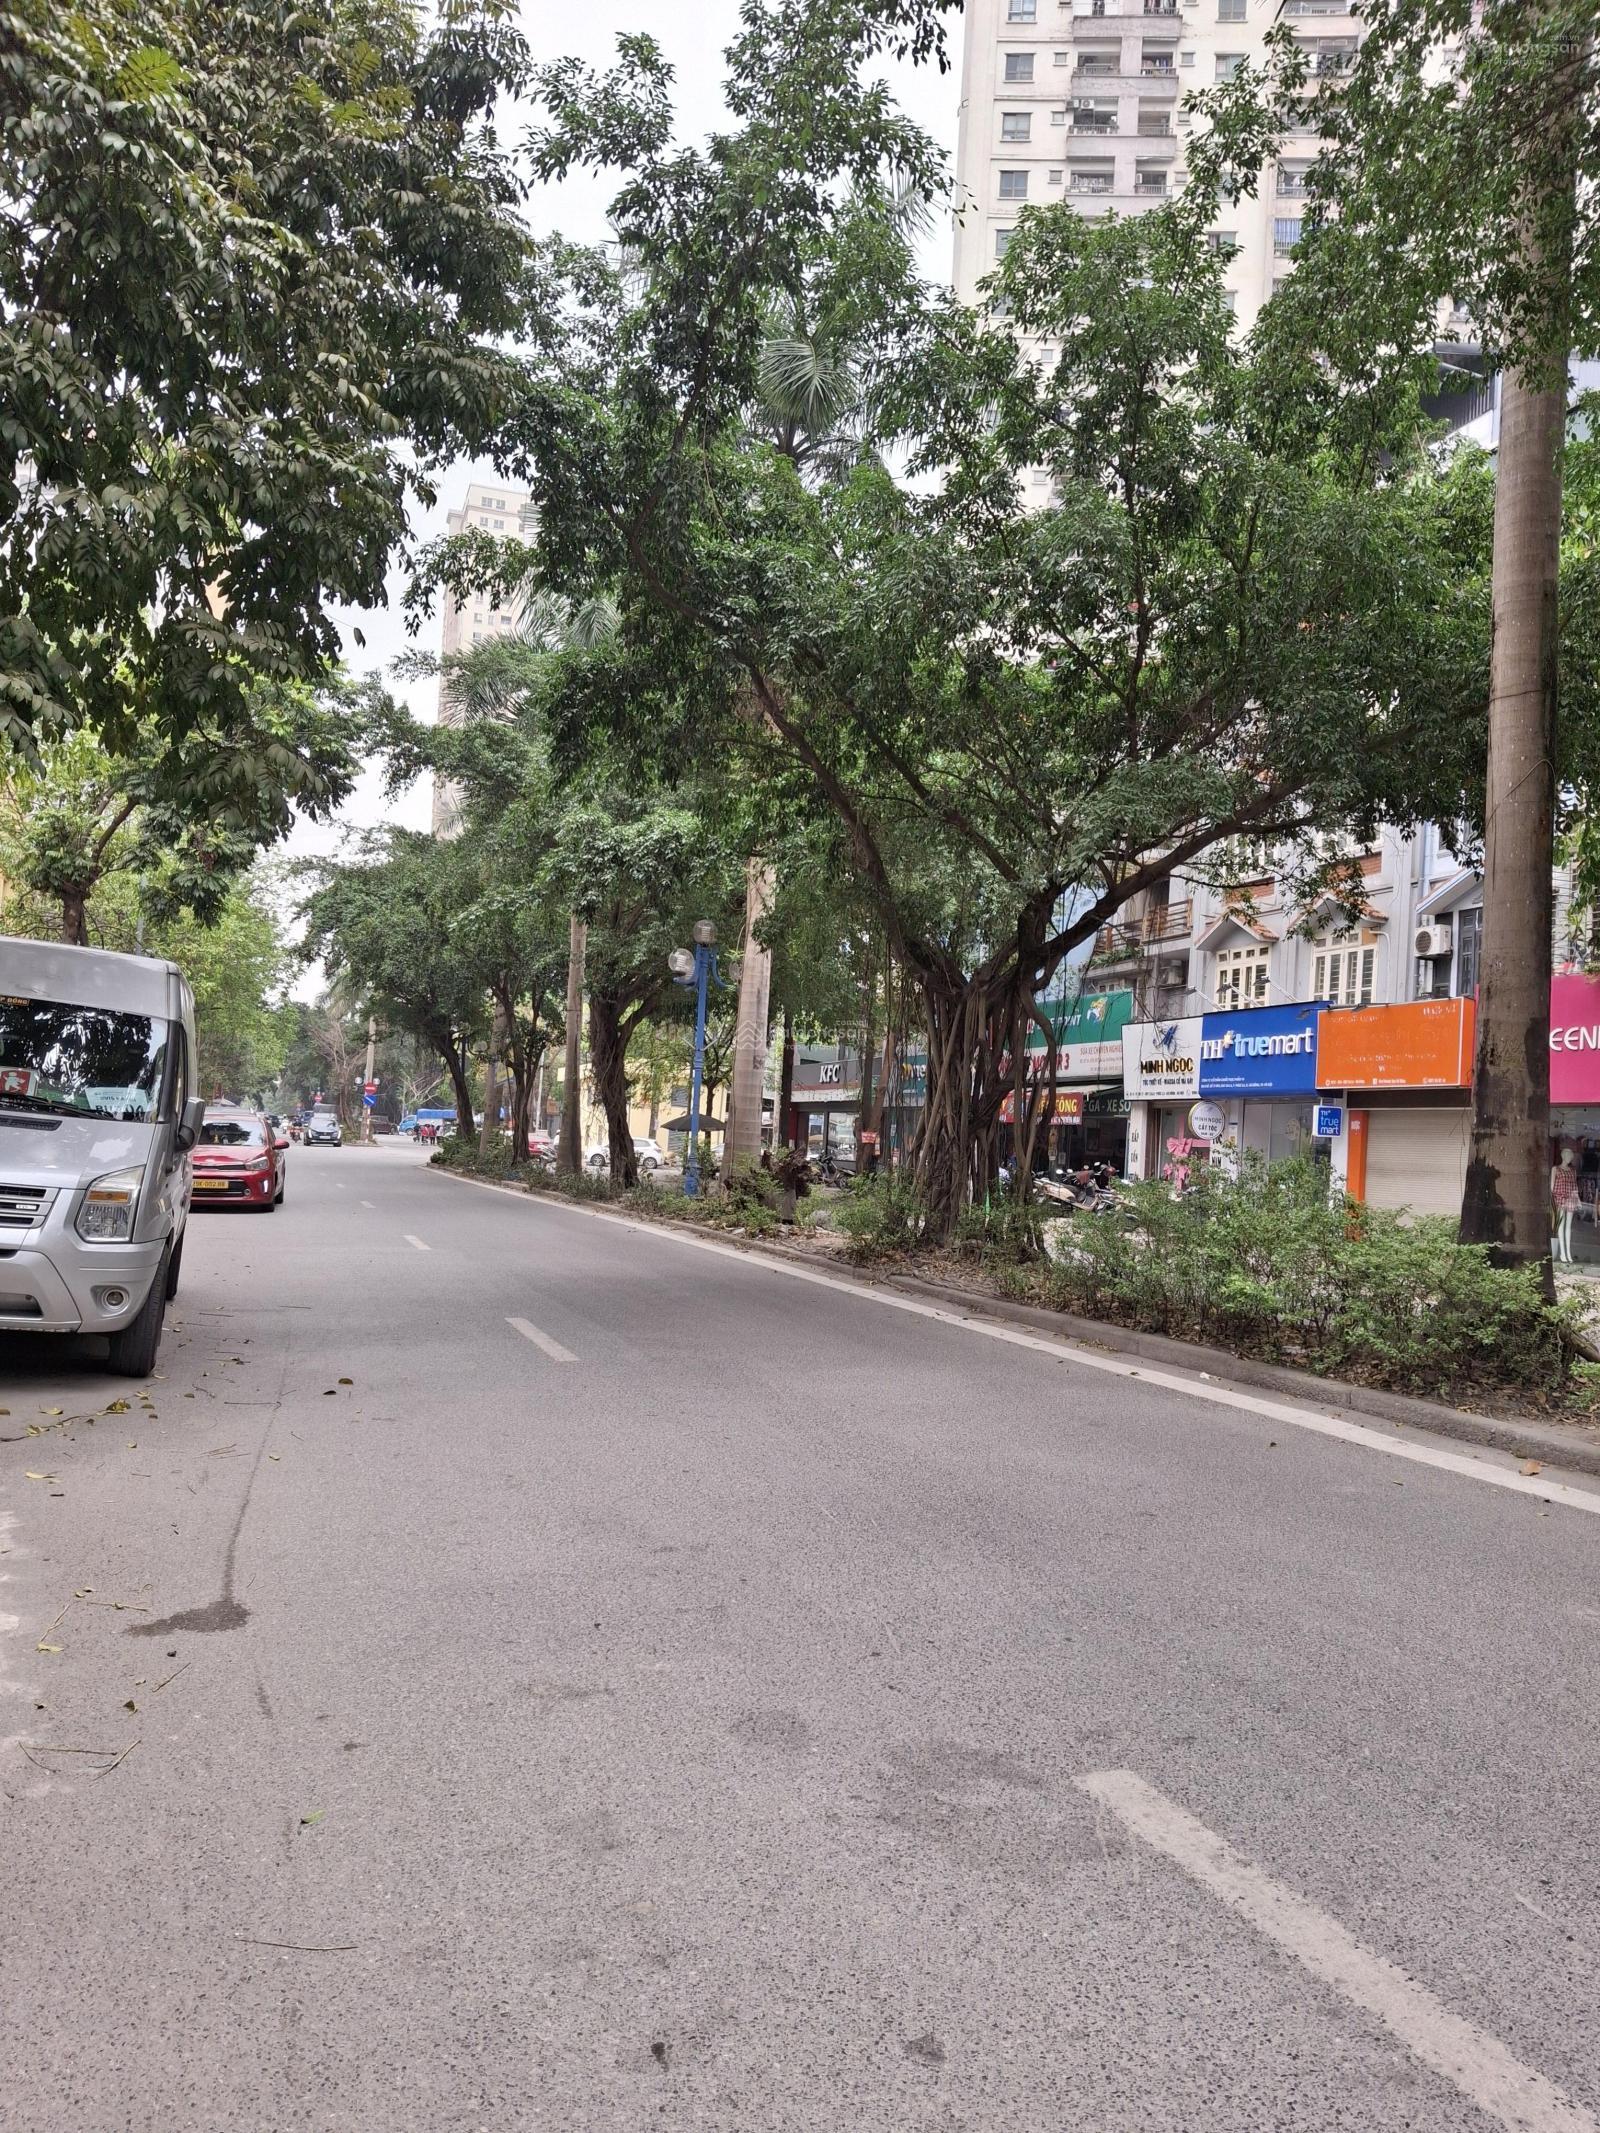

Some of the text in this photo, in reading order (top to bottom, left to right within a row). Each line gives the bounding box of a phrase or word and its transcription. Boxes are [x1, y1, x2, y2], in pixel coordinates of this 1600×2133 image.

[1201, 1040, 1224, 1059] TH
[1064, 1053, 1070, 1070] 3
[1141, 1057, 1194, 1075] MINH NGỌC
[820, 1065, 840, 1083] KFC
[1107, 1100, 1117, 1112] XE
[1321, 1117, 1339, 1126] true
[1321, 1126, 1339, 1134] mart
